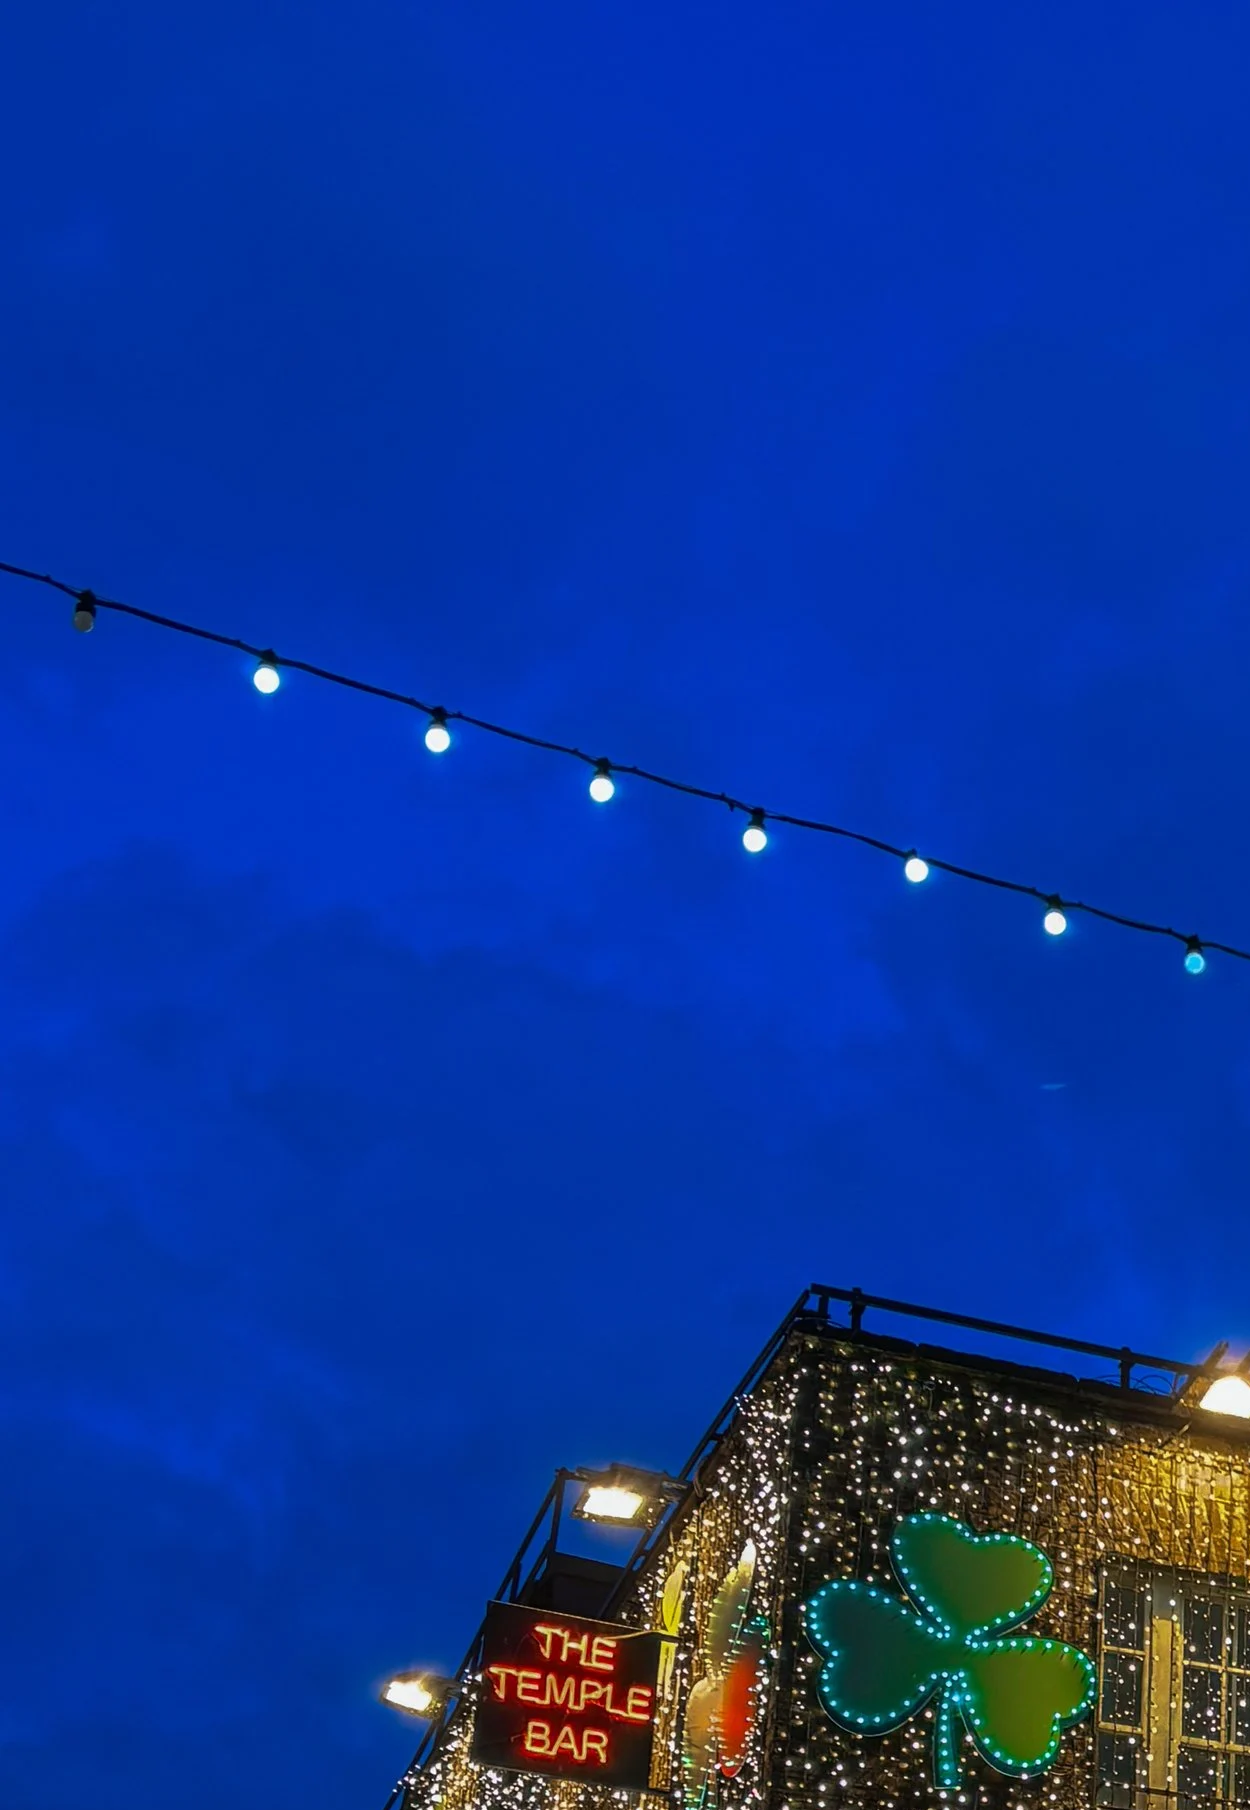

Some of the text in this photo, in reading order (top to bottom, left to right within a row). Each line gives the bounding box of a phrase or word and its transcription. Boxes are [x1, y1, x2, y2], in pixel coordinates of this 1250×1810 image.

[535, 1625, 617, 1671] THE
[489, 1666, 652, 1721] TEMPLE
[525, 1721, 609, 1764] BAR
